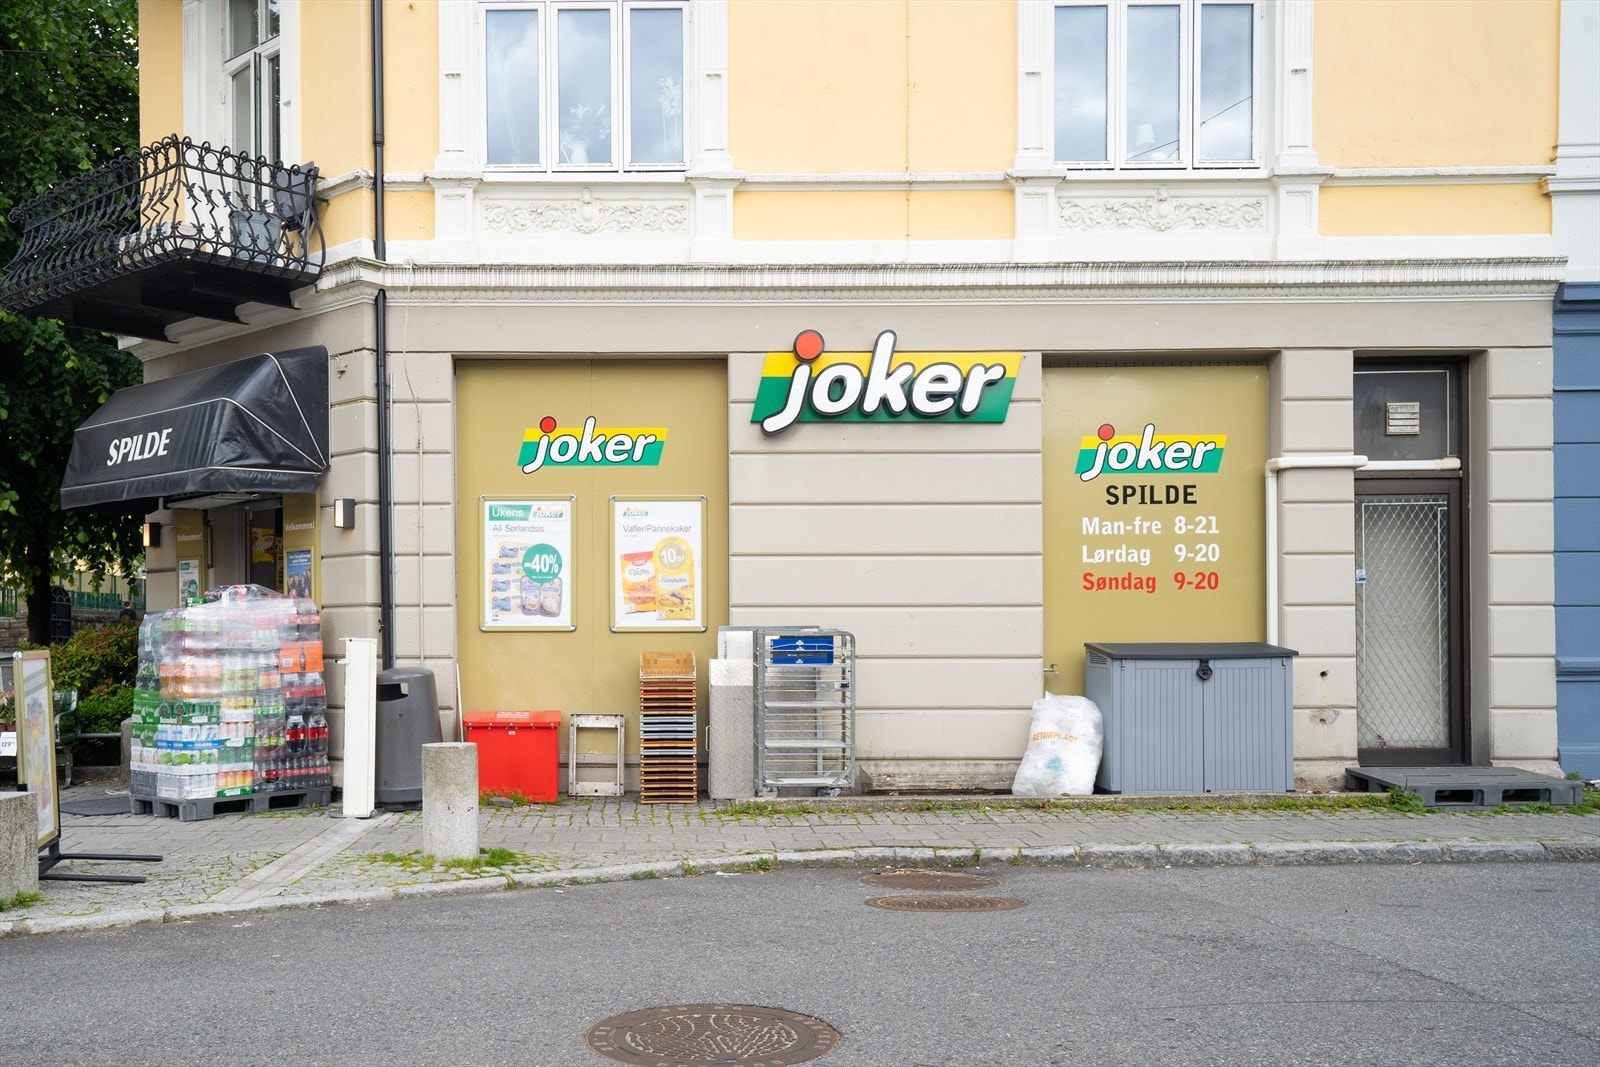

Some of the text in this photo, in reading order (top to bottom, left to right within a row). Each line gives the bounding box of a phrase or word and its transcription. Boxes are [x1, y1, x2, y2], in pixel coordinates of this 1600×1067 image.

[761, 329, 1006, 436] joker
[107, 428, 173, 467] SPILDE
[522, 416, 658, 475] joker
[1080, 423, 1216, 482] joker
[1106, 485, 1198, 506] SPILDE
[492, 507, 524, 517] Ukens
[505, 524, 545, 533] Sørlandsis
[623, 525, 692, 533] Vafler/Pannekaker
[1082, 515, 1220, 535] Man-fre 8-21
[524, 553, 559, 574] -40%
[1082, 543, 1220, 567] Lørdag 9-20
[1082, 571, 1219, 594] Søndag 9-20
